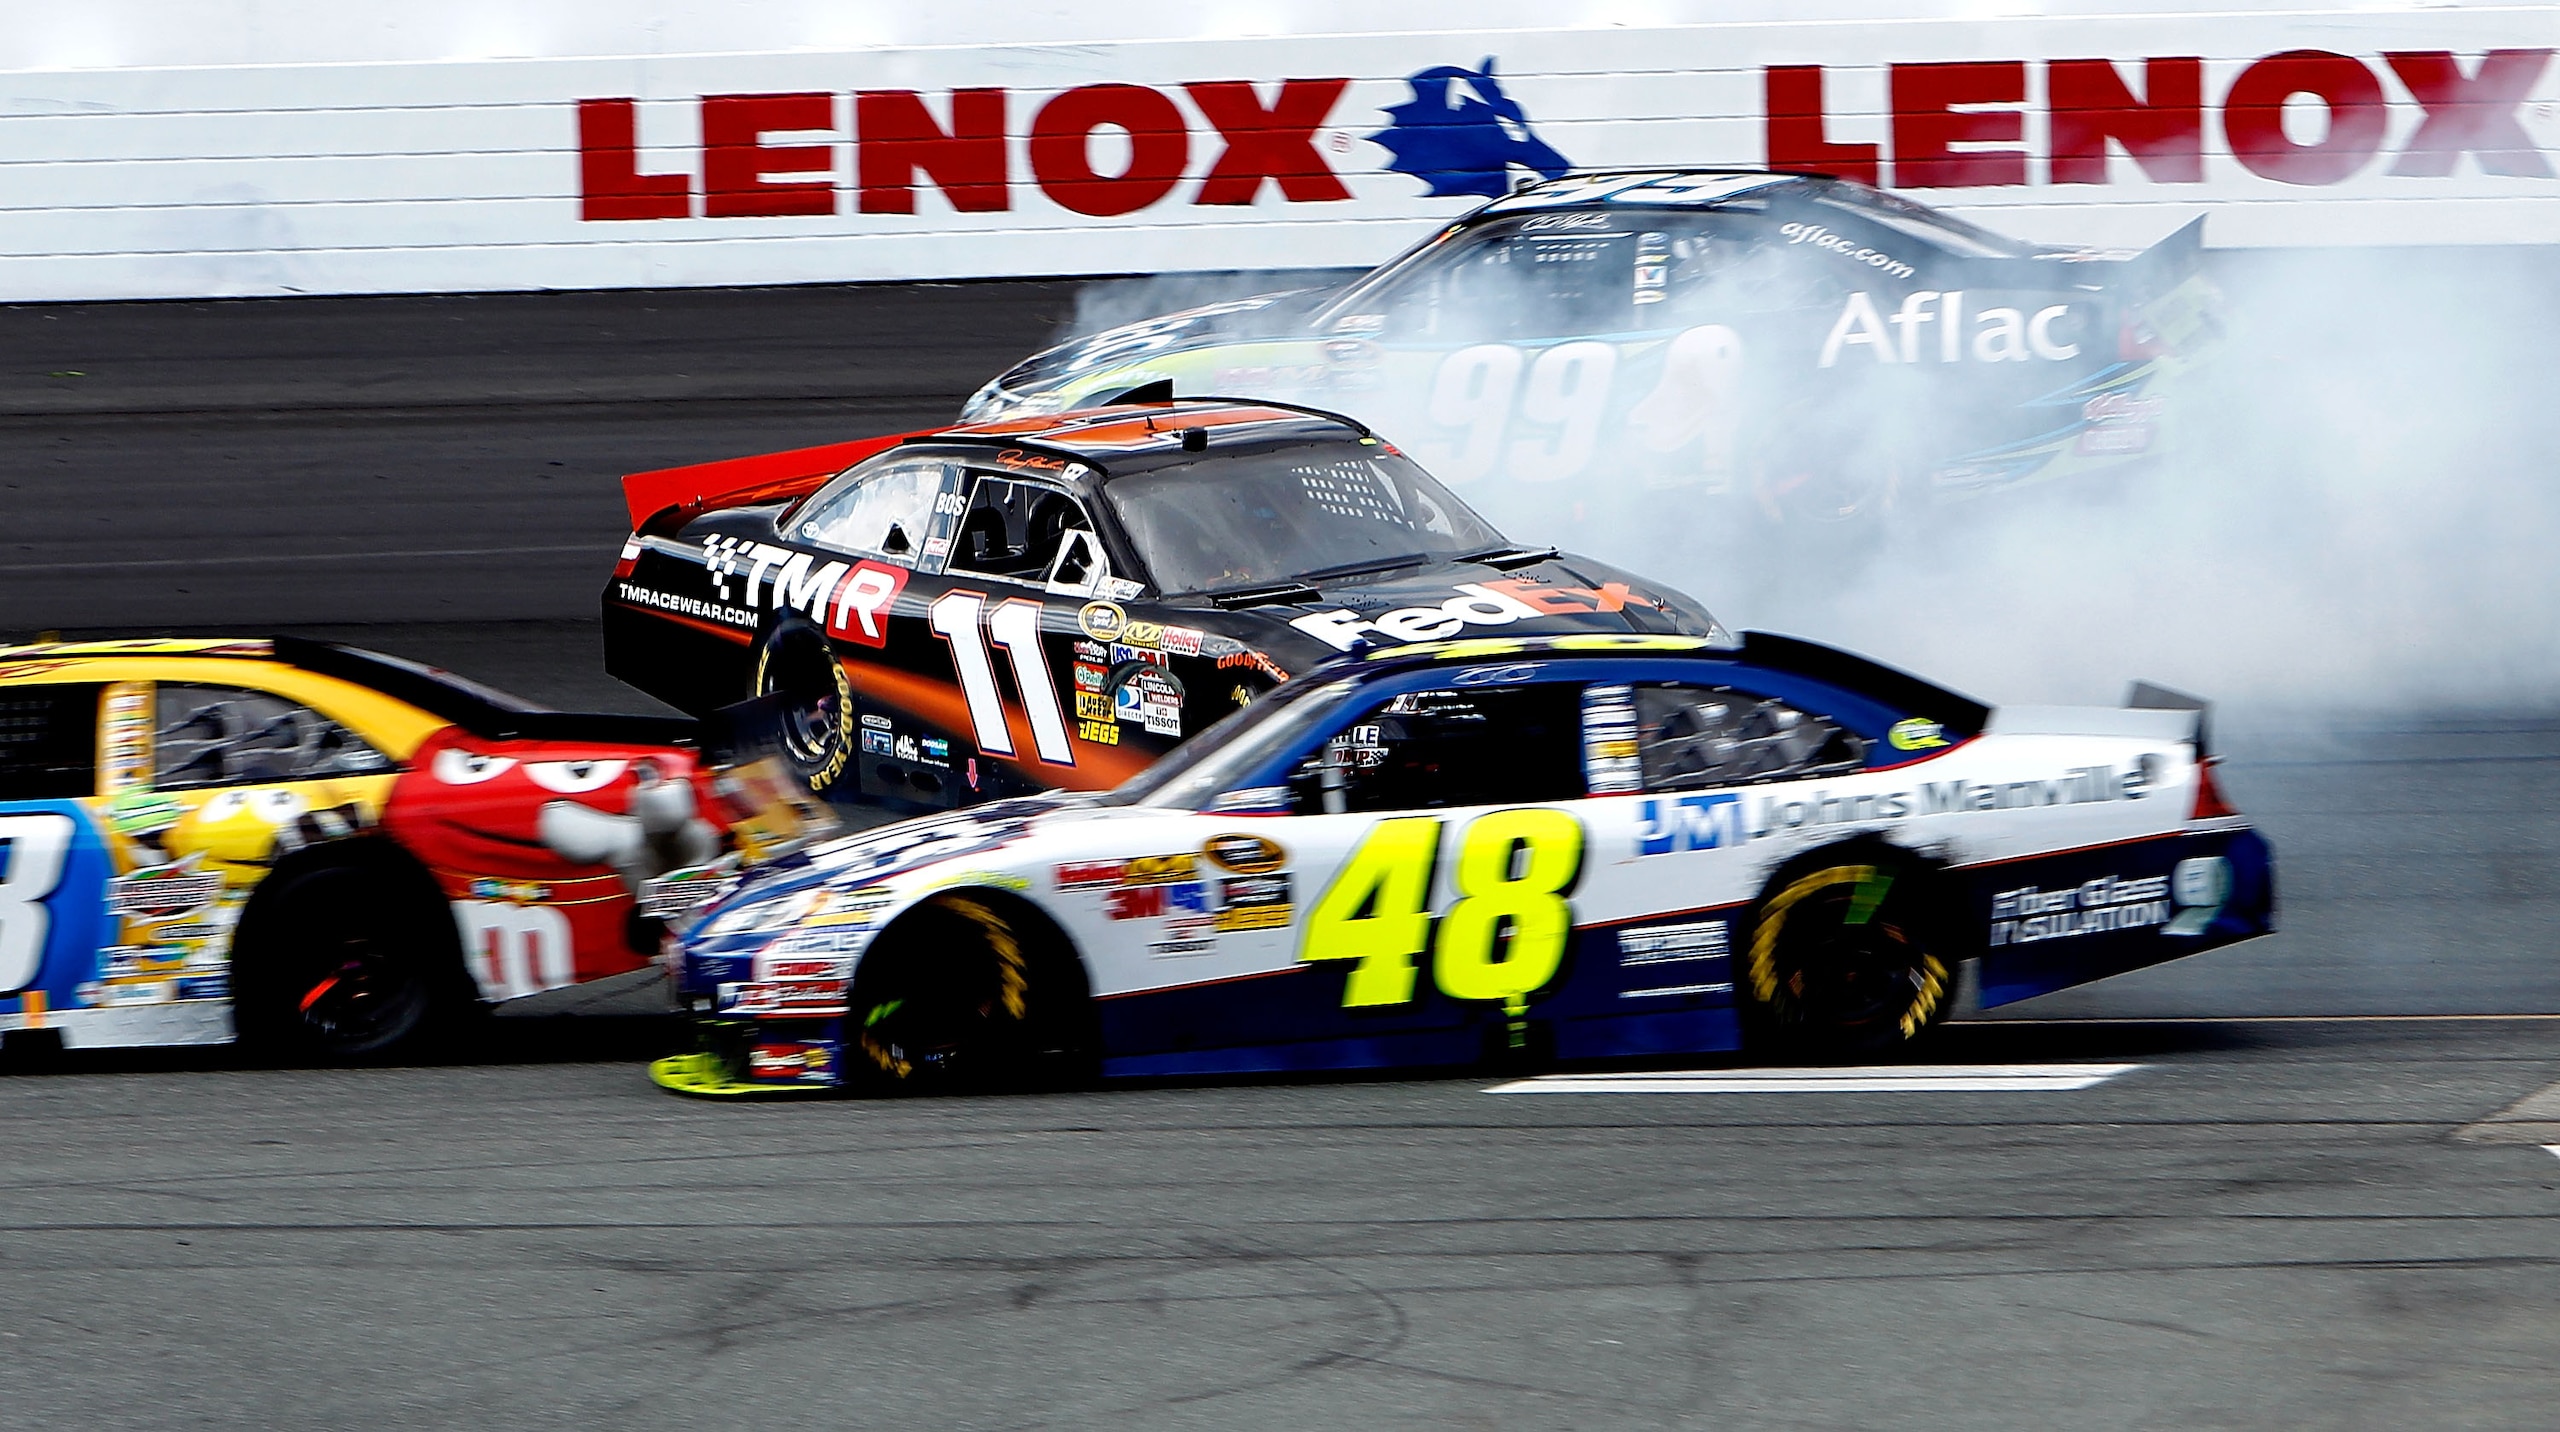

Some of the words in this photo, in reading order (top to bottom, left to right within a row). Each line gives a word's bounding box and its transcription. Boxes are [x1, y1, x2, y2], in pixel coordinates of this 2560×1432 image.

[578, 78, 1356, 221] LENOX
[1762, 48, 2554, 188] LENOX
[1780, 220, 1916, 279] aflac.com
[1817, 290, 2081, 368] Aflac
[1418, 342, 1617, 483] 99
[935, 492, 966, 517] BOS
[619, 582, 759, 628] TMRACEWEAR.COM
[744, 547, 896, 639] TMR
[1288, 579, 1656, 652] FedEx
[928, 588, 1074, 767] 11
[1163, 628, 1200, 654] Holley
[1079, 721, 1120, 746] JEGS
[1146, 715, 1178, 729] TISSOT
[1297, 807, 1584, 1007] 48
